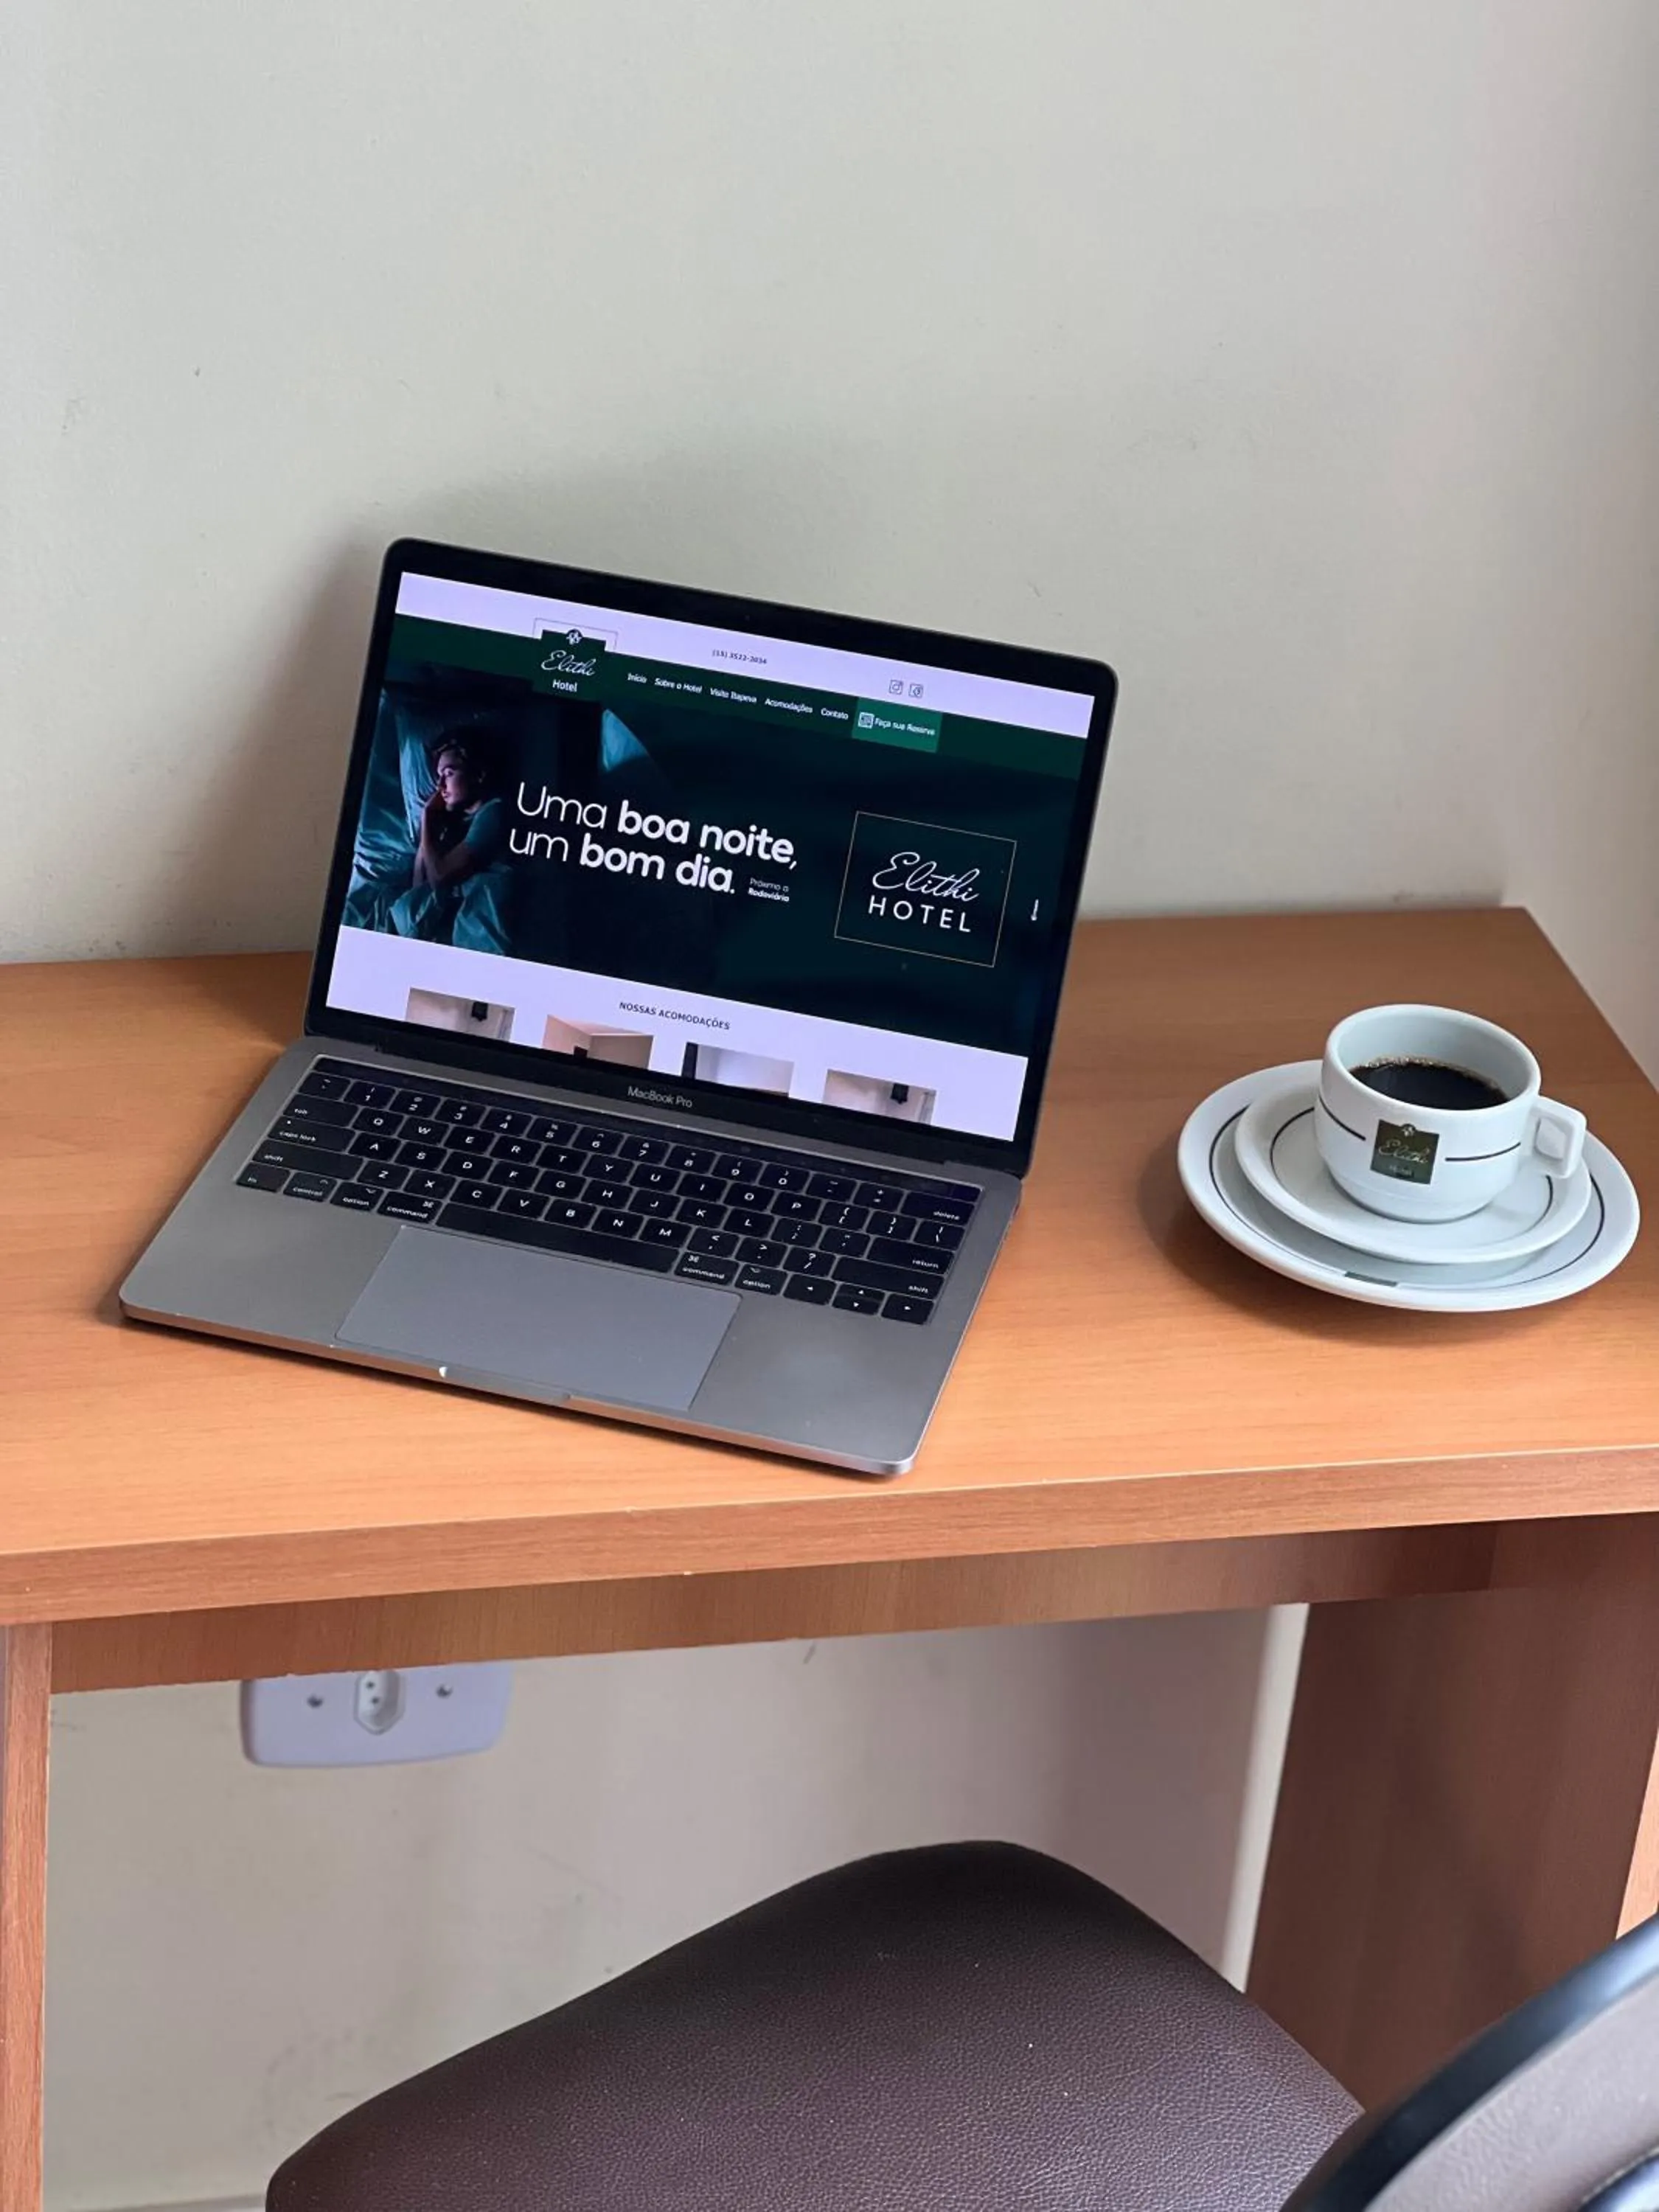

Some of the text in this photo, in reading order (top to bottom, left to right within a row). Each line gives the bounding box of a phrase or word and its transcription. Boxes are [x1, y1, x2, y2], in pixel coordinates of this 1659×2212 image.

[552, 679, 578, 692] Hotel
[654, 677, 675, 689] Sobre
[683, 683, 703, 694] Hotel
[731, 690, 757, 703] Itapeva
[765, 698, 813, 713] Acomodações
[821, 707, 849, 720] Contato
[874, 717, 935, 735] Faça sua Reserva
[517, 782, 797, 870] Uma boa noite,
[509, 829, 736, 894] um bom dia.
[872, 852, 980, 902] Elithi
[748, 887, 790, 902] Rodoviária
[868, 895, 971, 933] HOTEL
[619, 1001, 731, 1030] NOSSAS ACOMODAÇÕES
[627, 1085, 693, 1108] MacBook Pro
[386, 1205, 429, 1220] command
